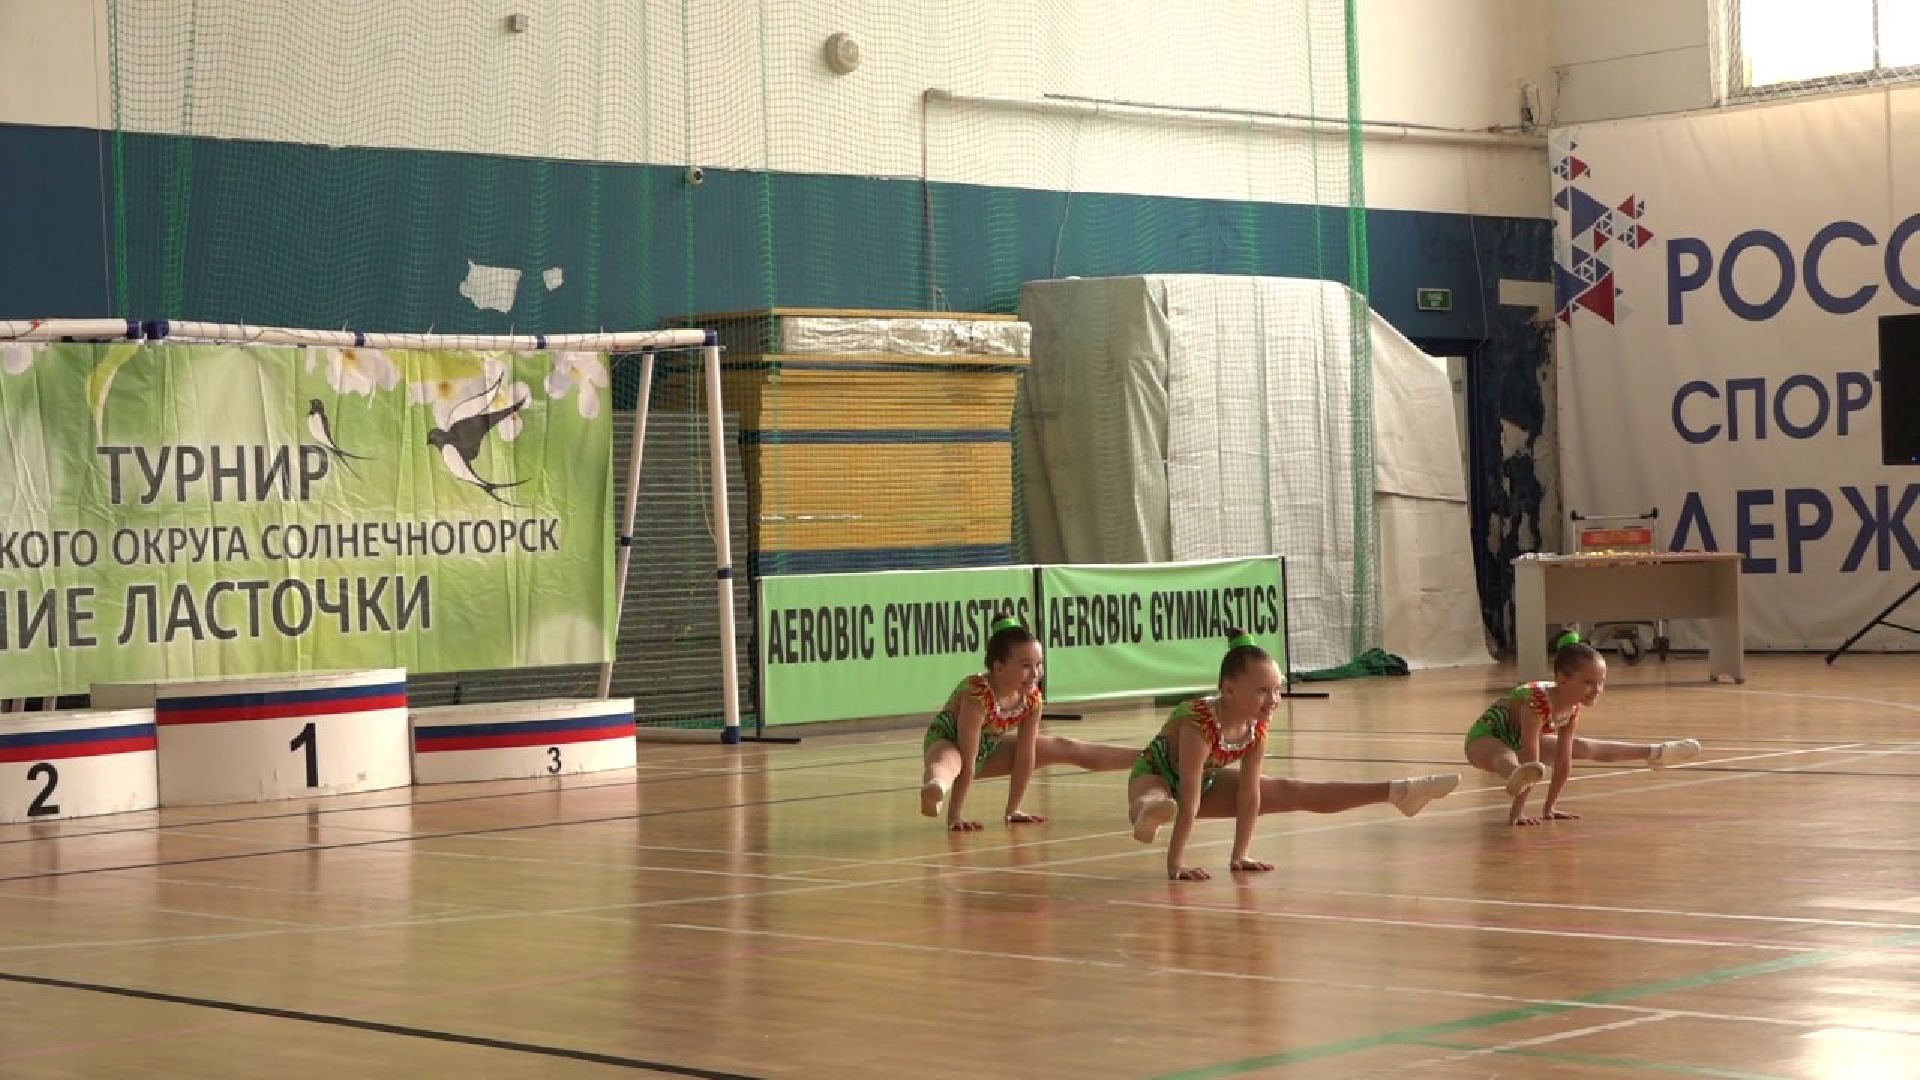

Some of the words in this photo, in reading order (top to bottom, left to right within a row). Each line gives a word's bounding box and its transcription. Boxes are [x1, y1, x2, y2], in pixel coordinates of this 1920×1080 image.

[1671, 371, 1881, 445] СПОР
[97, 444, 329, 505] ТУРНИР
[113, 525, 250, 565] ОКРУГА
[261, 517, 559, 560] СОЛНЕЧНОГОРСК
[117, 575, 431, 646] ЛАСТОЧКИ
[767, 602, 875, 665] AEROBIC
[1049, 592, 1142, 649] AEROBIC
[1150, 584, 1278, 642] GYMNASTICS
[290, 722, 319, 788] 1
[546, 746, 563, 775] 3
[26, 762, 61, 817] 2
